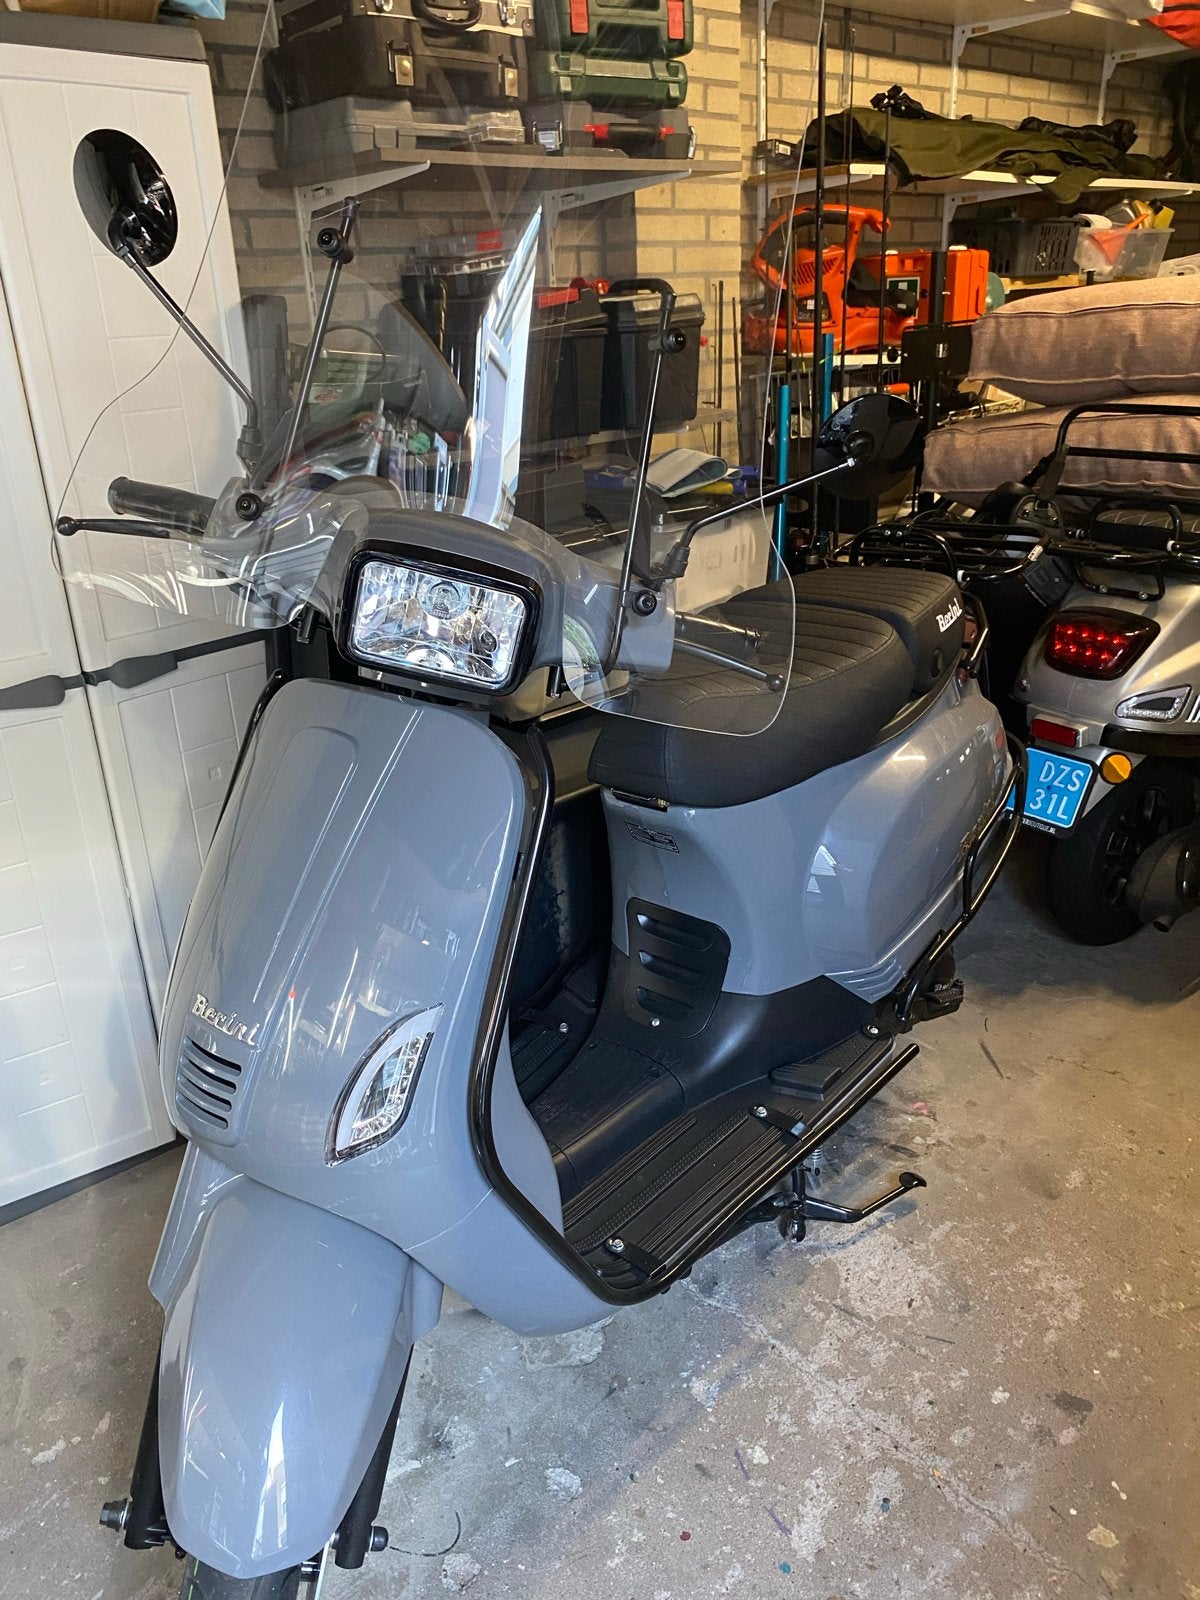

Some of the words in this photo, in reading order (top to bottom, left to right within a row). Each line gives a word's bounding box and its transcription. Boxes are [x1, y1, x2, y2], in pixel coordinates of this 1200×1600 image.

[1039, 760, 1085, 792] DZS
[1029, 788, 1069, 821] 31L
[191, 993, 261, 1047] Berini
